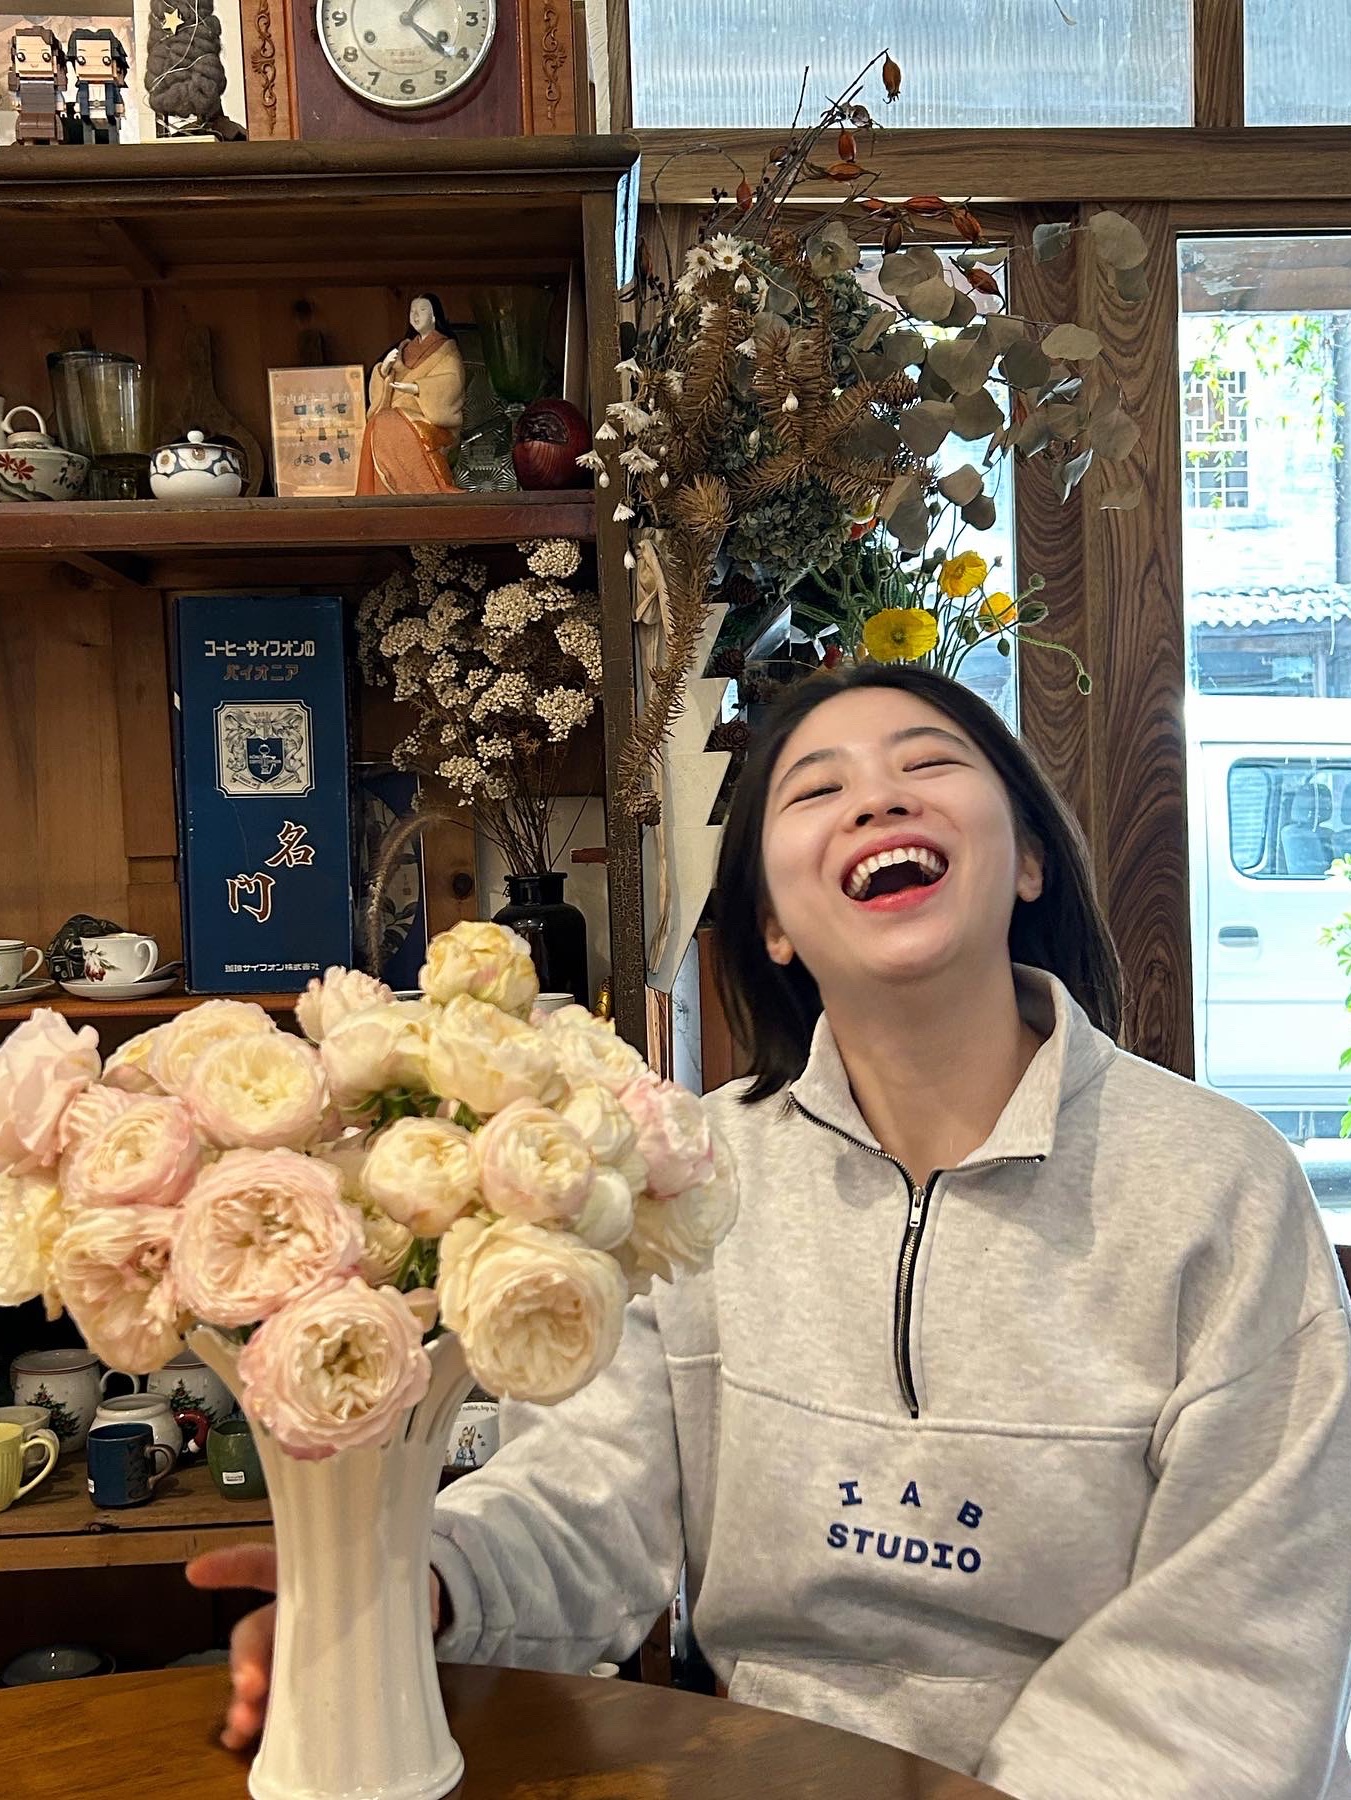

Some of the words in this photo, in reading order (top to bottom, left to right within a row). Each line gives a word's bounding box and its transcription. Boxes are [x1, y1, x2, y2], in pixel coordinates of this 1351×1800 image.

[332, 11, 347, 27] 9
[466, 12, 479, 26] 3
[343, 46, 358, 62] 8
[456, 47, 470, 61] 4
[368, 72, 381, 86] 7
[434, 70, 447, 85] 5
[400, 79, 416, 94] 6
[827, 1523, 981, 1573] STUDIO
